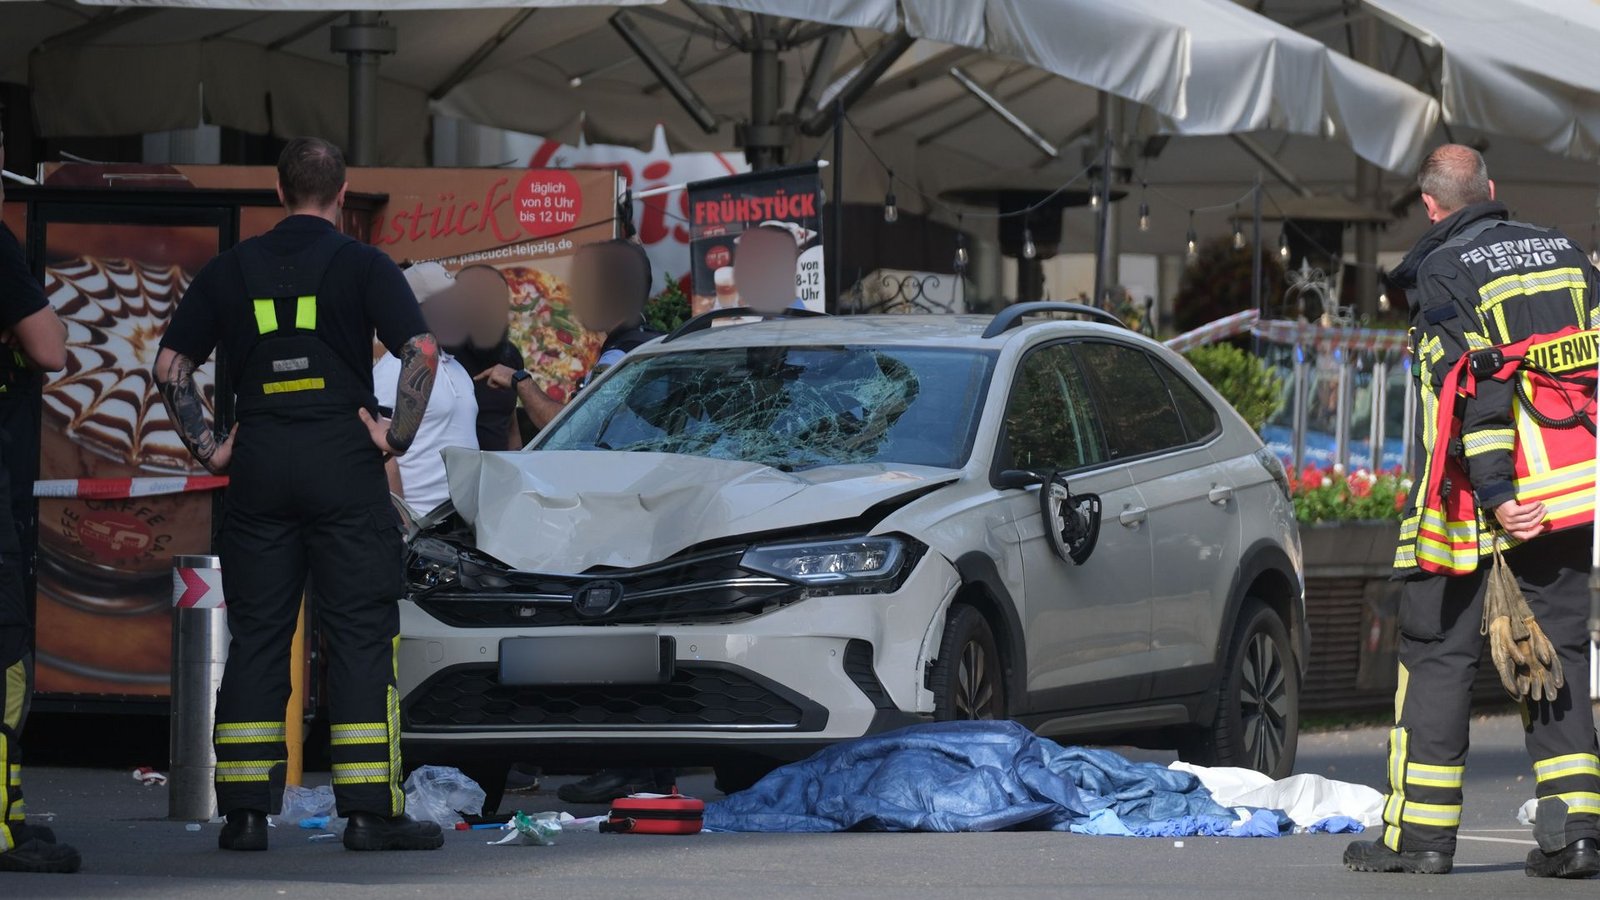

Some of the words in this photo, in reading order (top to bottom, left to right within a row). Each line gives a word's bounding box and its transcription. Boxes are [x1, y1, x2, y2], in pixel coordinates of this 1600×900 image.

[531, 181, 566, 196] täglich
[521, 198, 542, 208] von
[544, 196, 552, 208] 8
[554, 196, 575, 208] Uhr
[695, 189, 816, 225] FRÜHSTÜCK
[519, 210, 536, 222] bis
[539, 210, 553, 222] 12
[555, 211, 576, 223] Uhr
[1461, 237, 1572, 267] FEUERWEHR
[801, 260, 819, 271] von
[1486, 250, 1557, 273] LEIPZIG
[795, 272, 820, 286] 8-12
[801, 287, 820, 301] Uhr
[1525, 335, 1599, 369] UERW
